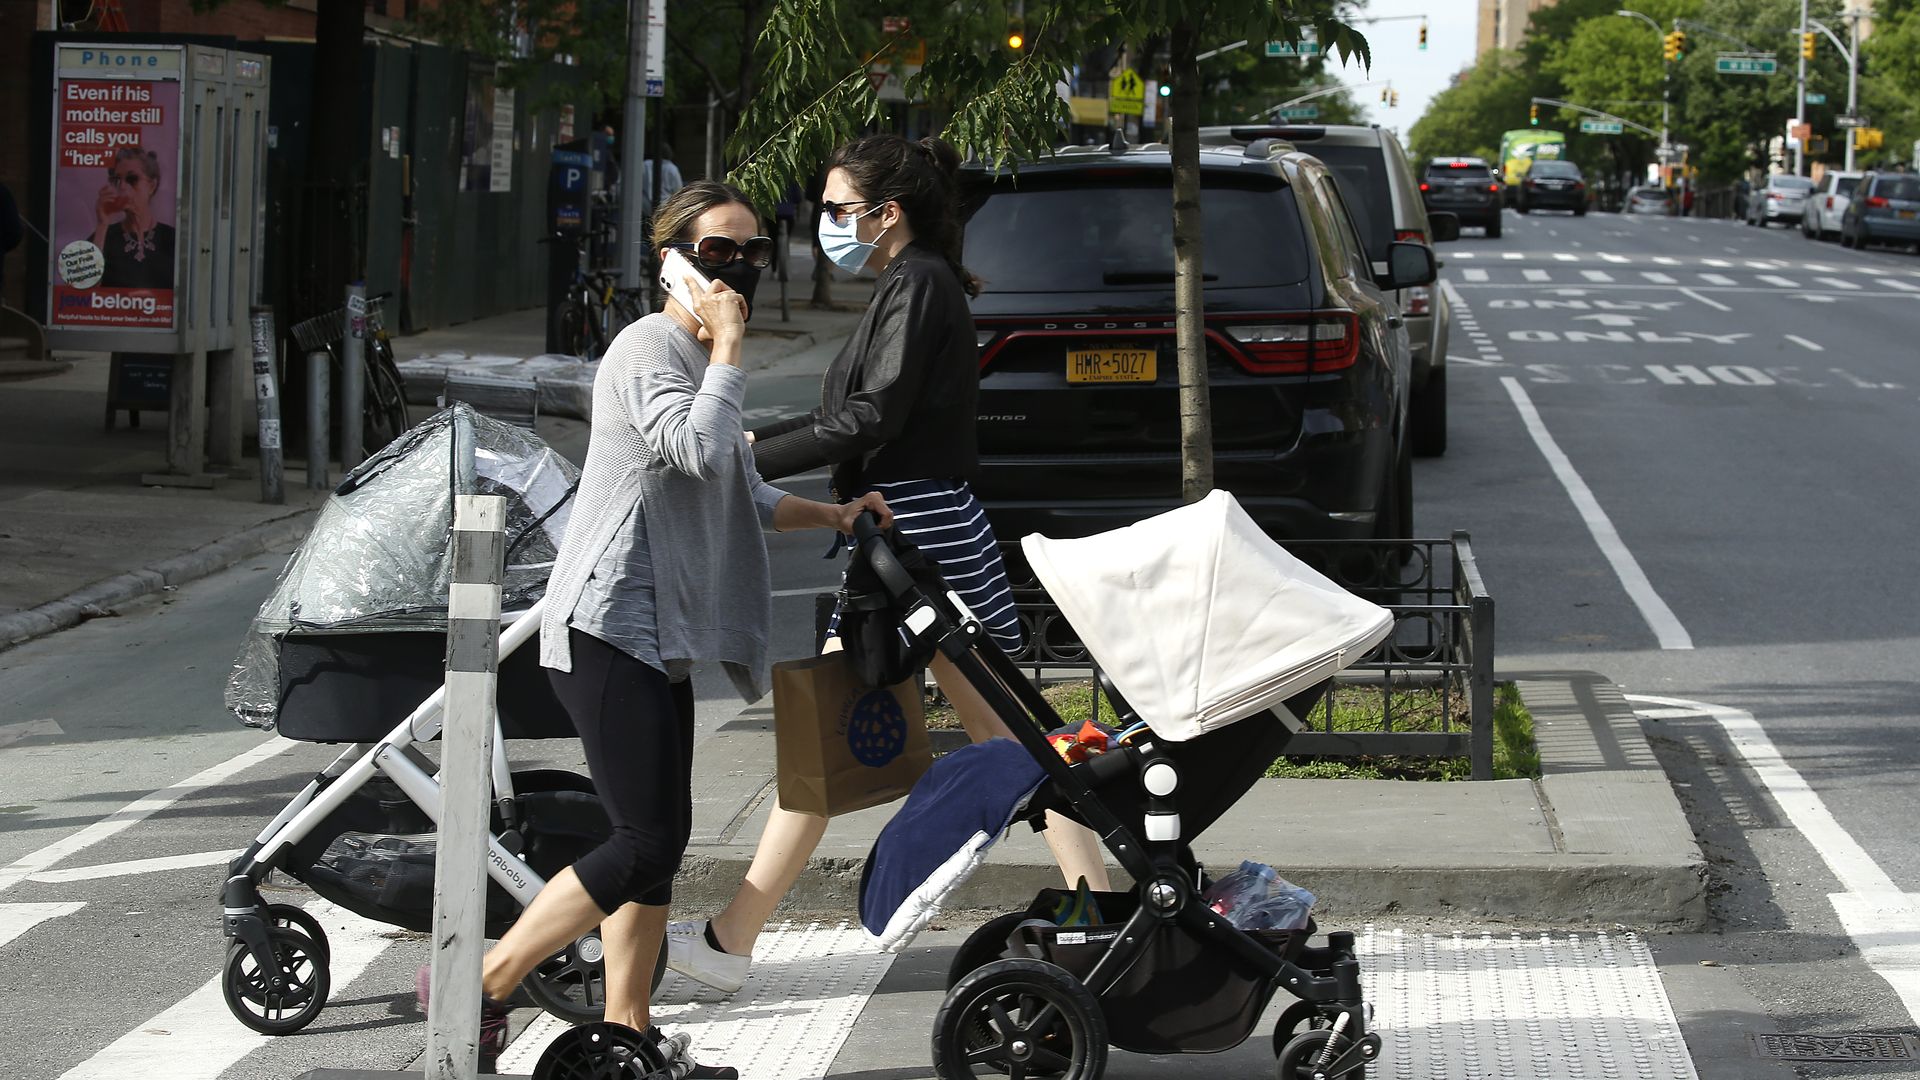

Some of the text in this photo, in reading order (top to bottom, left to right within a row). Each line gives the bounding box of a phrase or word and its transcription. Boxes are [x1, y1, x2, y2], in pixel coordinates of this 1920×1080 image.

[82, 51, 158, 66] Phone
[67, 84, 150, 102] Even if his
[66, 107, 160, 123] mother still
[65, 128, 139, 147] calls you
[65, 150, 113, 166] “her.”
[566, 168, 581, 189] P
[1488, 299, 1685, 311] ONLY
[1044, 321, 1176, 330] DODGE
[1507, 330, 1754, 345] ONLY
[1075, 352, 1147, 375] HMR 5027
